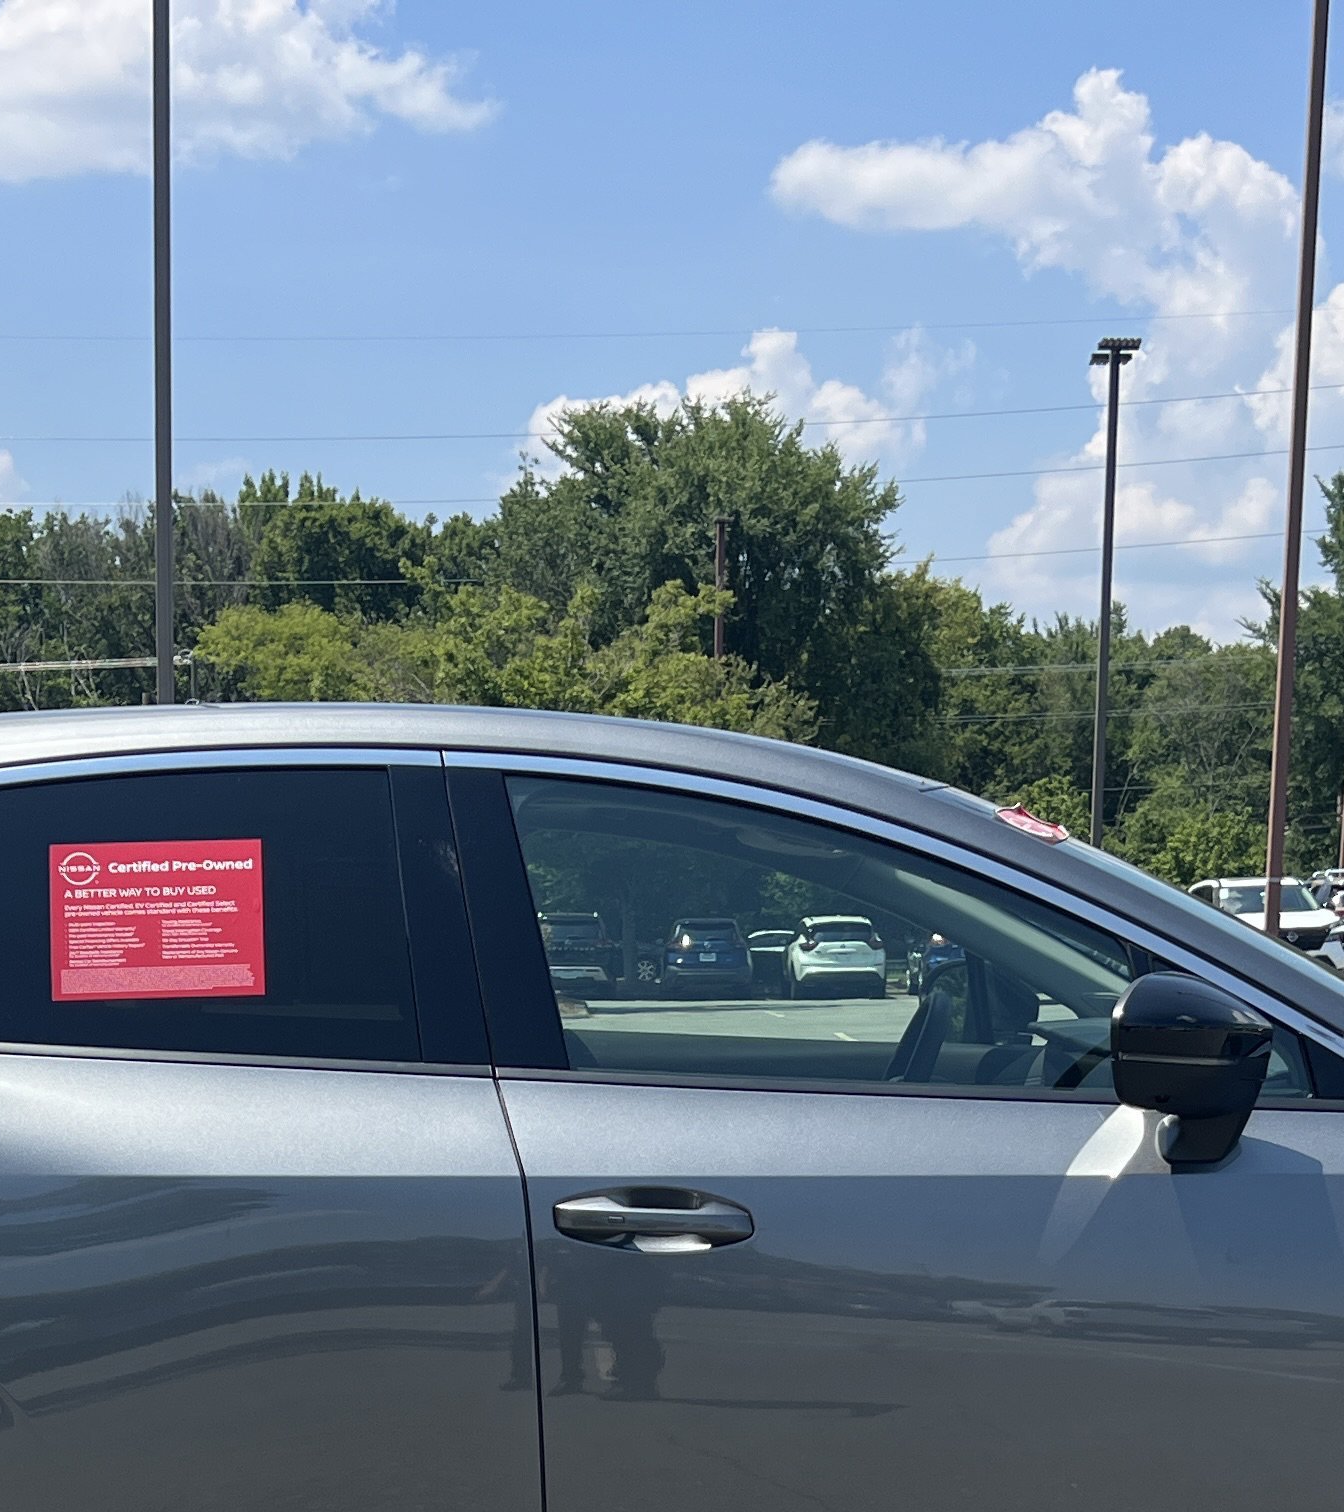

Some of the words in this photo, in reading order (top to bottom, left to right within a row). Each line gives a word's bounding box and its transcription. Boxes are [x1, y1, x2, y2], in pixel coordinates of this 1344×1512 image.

[58, 864, 100, 873] NISSAN
[108, 860, 170, 874] Certified
[172, 858, 253, 872] Pre-Owned
[64, 889, 73, 899] A
[75, 888, 117, 899] BETTER
[118, 887, 143, 897] WAY
[144, 887, 160, 897] TO
[163, 886, 185, 896] BUY
[187, 885, 217, 895] USED
